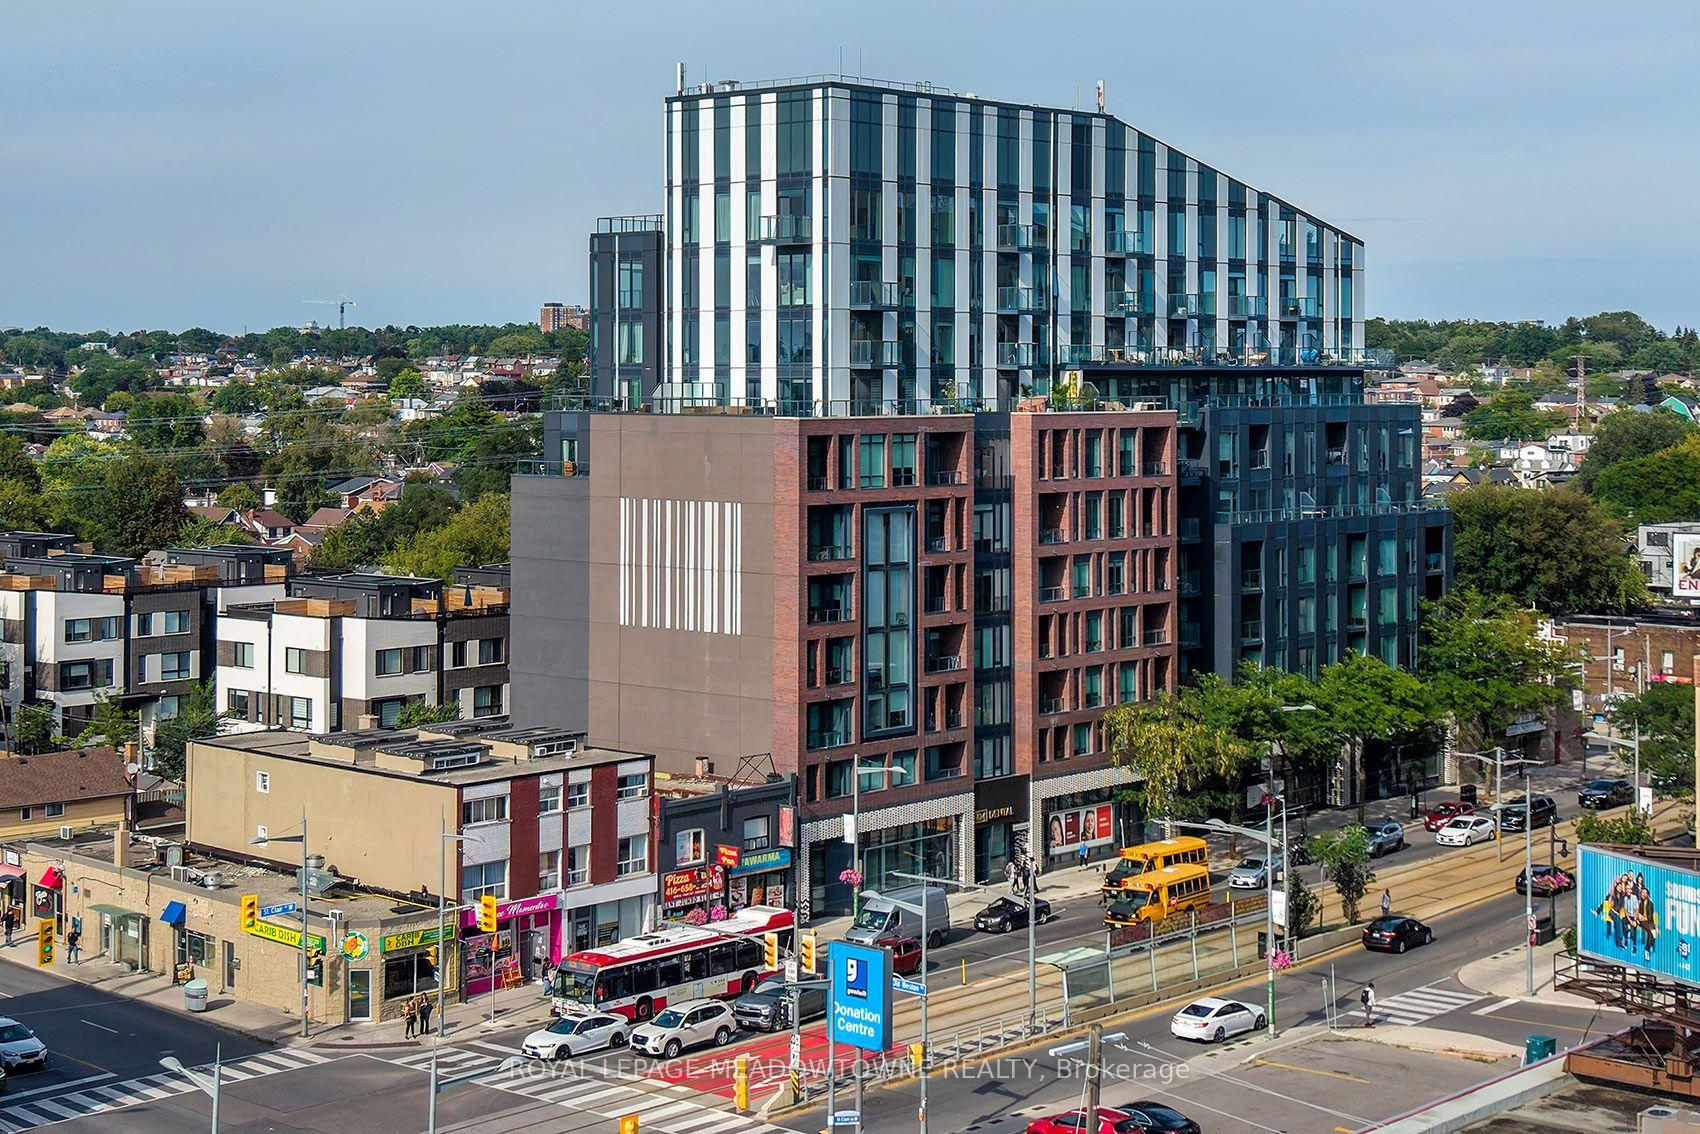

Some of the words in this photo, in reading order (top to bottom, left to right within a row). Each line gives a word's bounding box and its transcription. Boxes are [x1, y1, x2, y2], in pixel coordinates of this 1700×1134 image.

[1679, 579, 1700, 591] EN
[741, 851, 780, 867] AWARMA
[665, 873, 690, 886] Pizza
[834, 1001, 880, 1024] Donation
[837, 1017, 875, 1037] Centre
